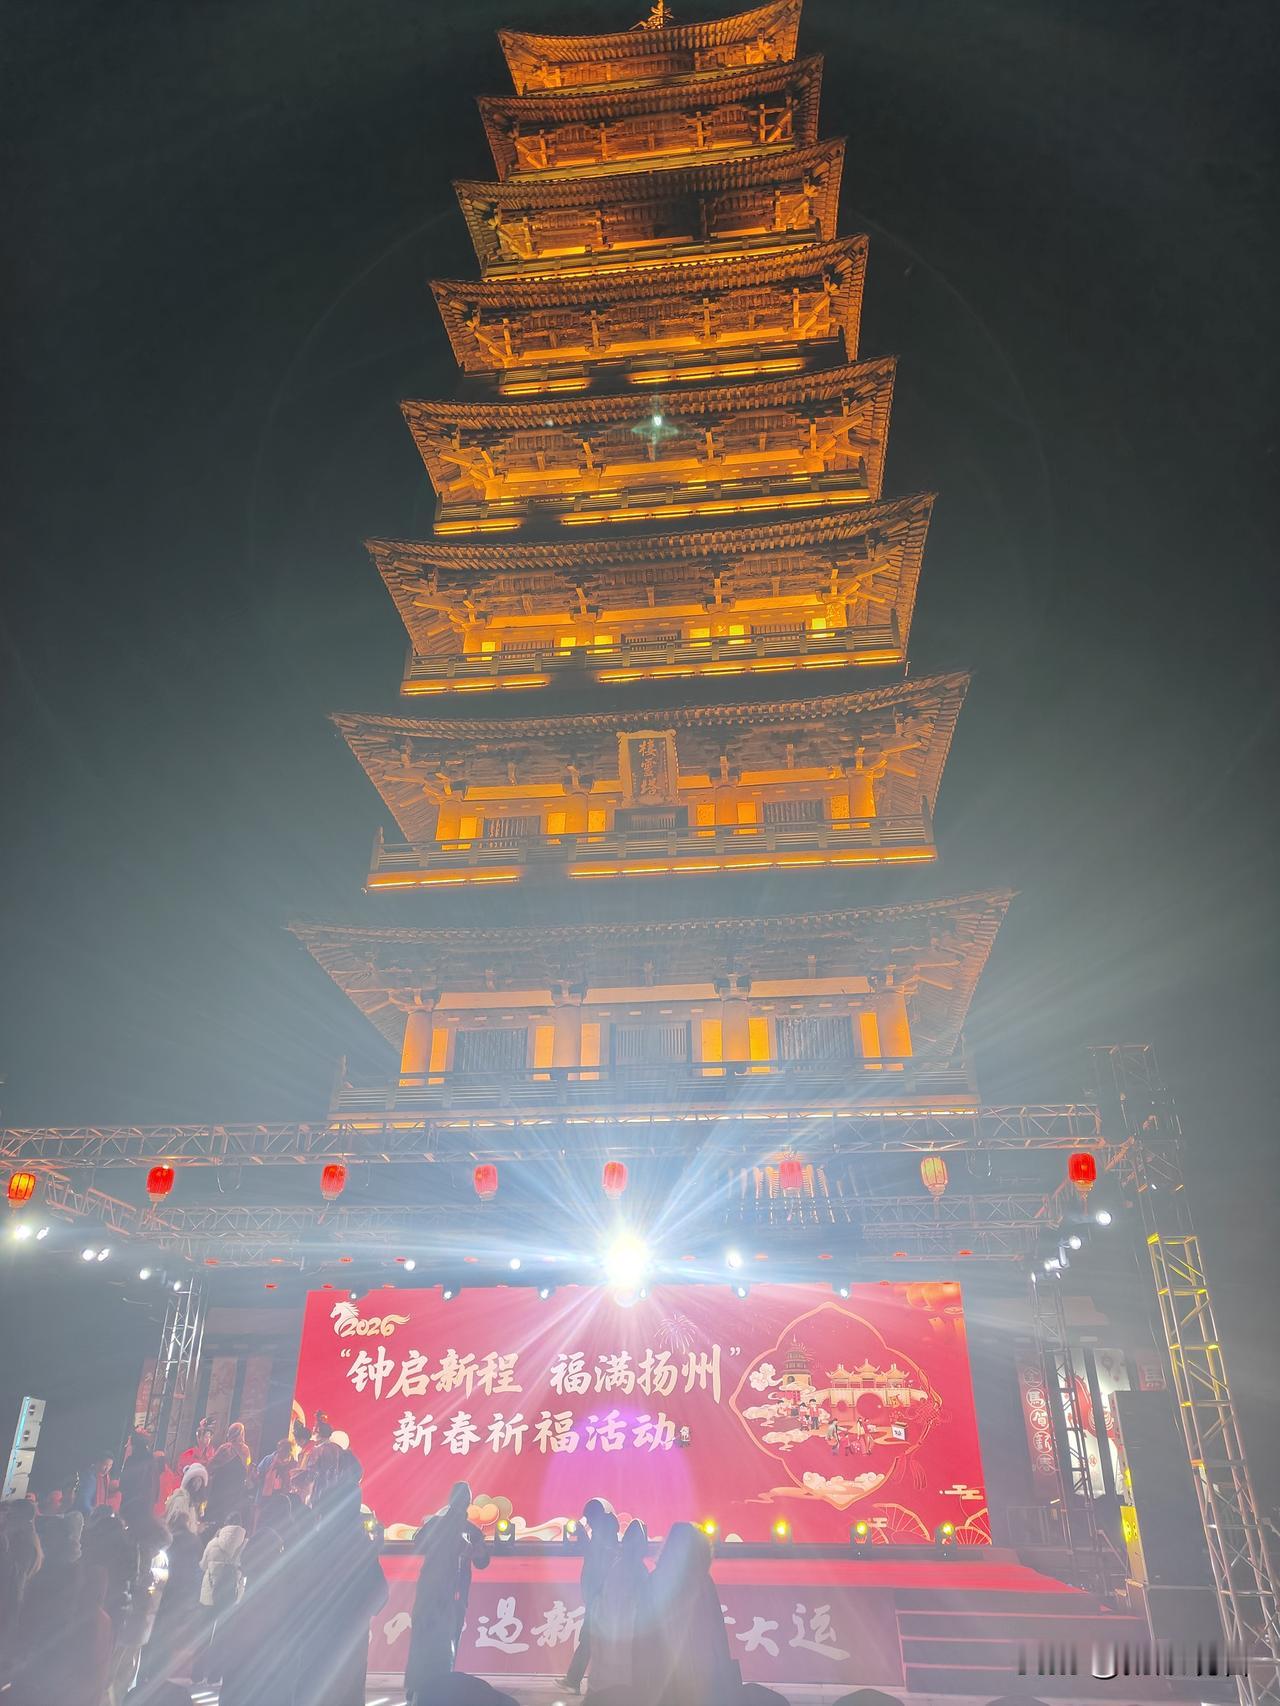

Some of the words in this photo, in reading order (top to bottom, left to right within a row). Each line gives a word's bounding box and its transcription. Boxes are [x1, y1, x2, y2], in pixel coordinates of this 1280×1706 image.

[339, 1314, 411, 1338] 2026
[392, 1409, 676, 1456] 新春祈福活动
[720, 1603, 851, 1661] 大运
